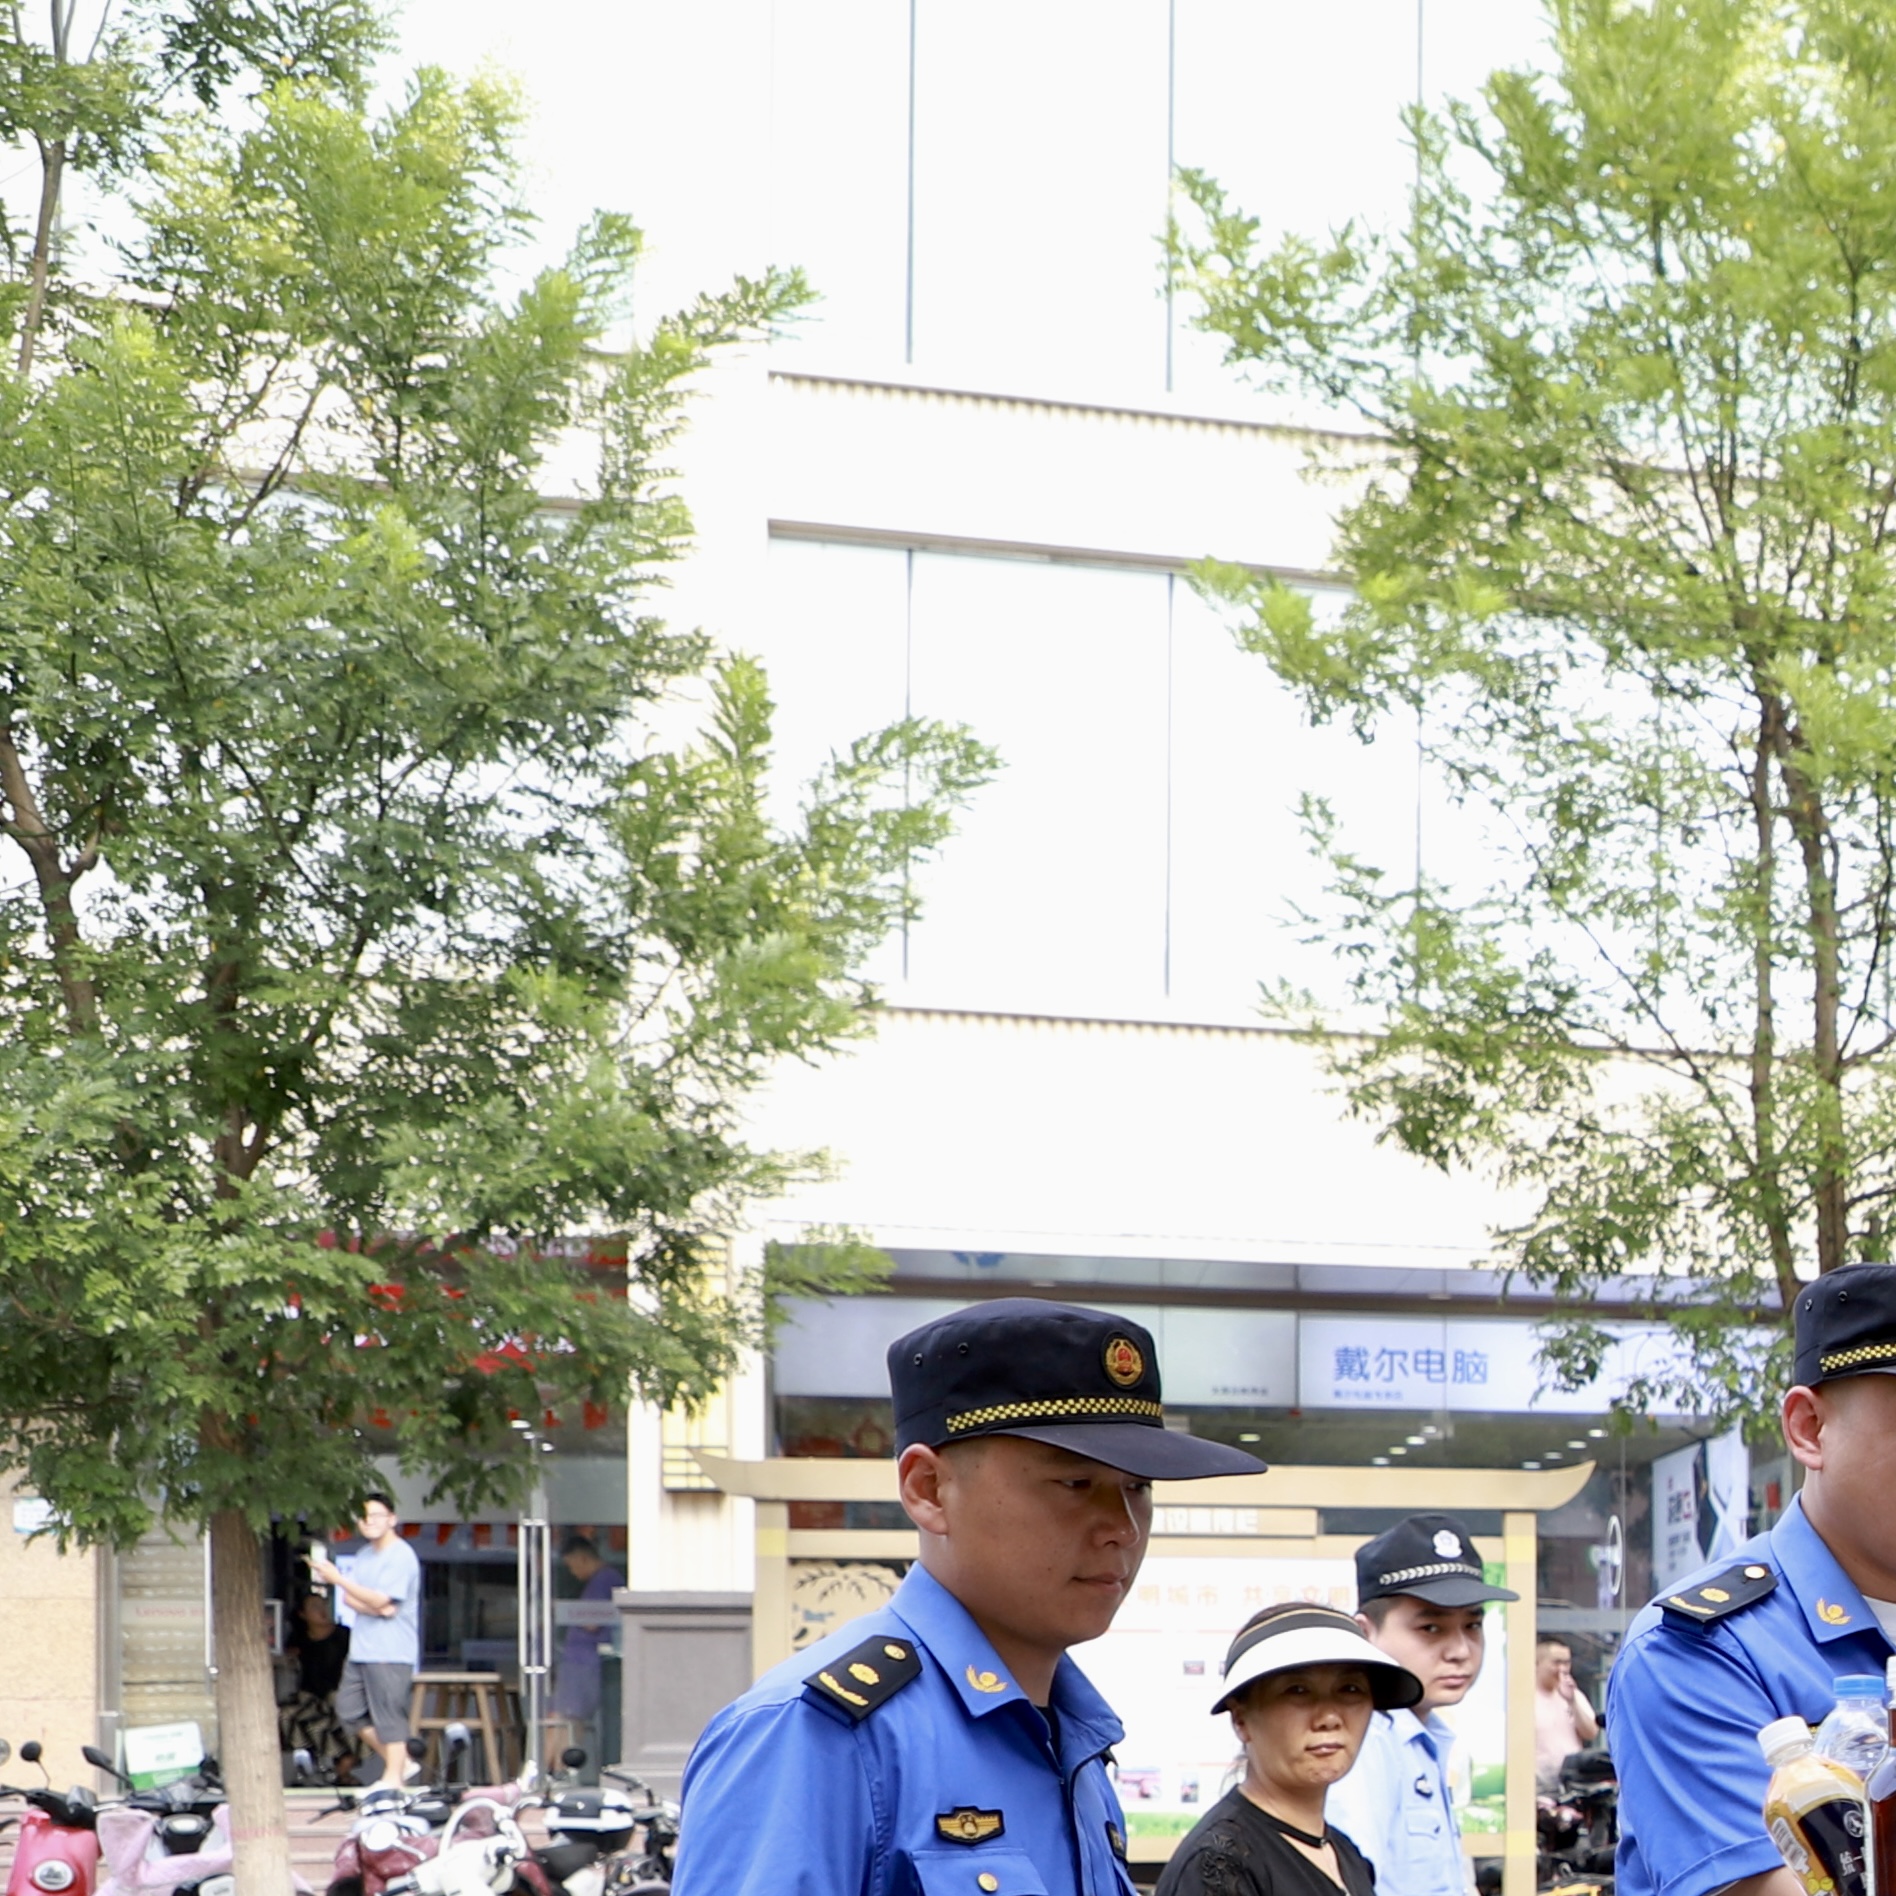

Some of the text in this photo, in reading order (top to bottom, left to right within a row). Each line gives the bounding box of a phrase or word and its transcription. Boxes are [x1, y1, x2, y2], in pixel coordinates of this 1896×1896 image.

[1333, 1346, 1488, 1384] 戴尔电脑
[1136, 1584, 1218, 1606] 明城市
